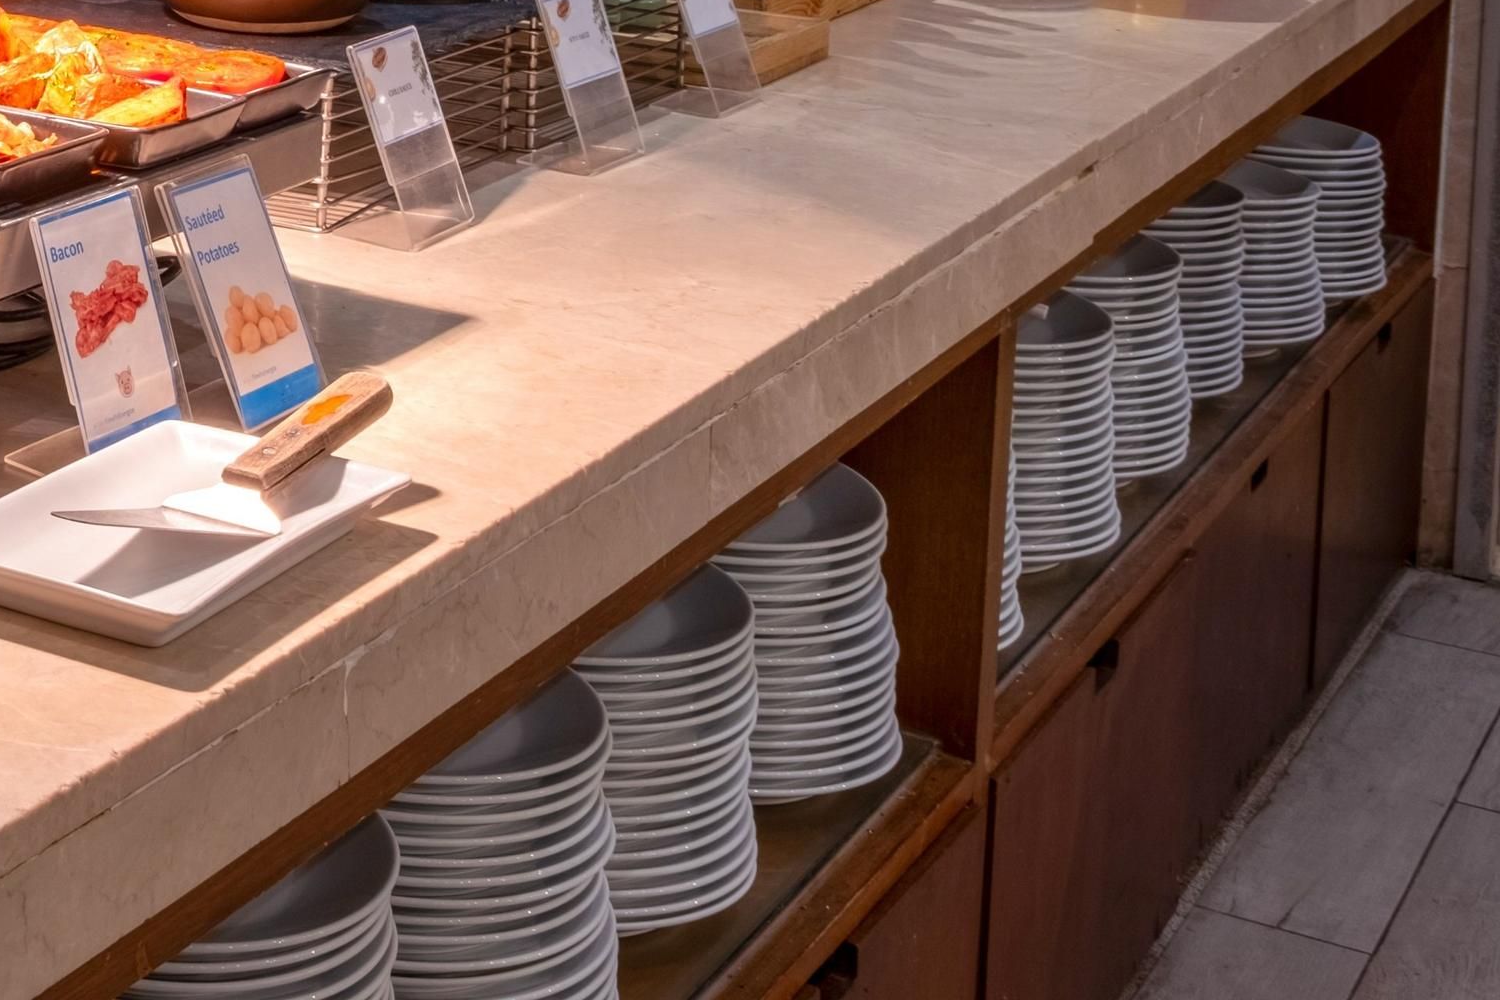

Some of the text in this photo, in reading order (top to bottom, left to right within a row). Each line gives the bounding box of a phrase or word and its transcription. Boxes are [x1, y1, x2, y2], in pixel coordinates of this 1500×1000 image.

[185, 204, 225, 232] Sautéed
[50, 241, 84, 263] Bacon
[197, 240, 240, 266] Potatoes
